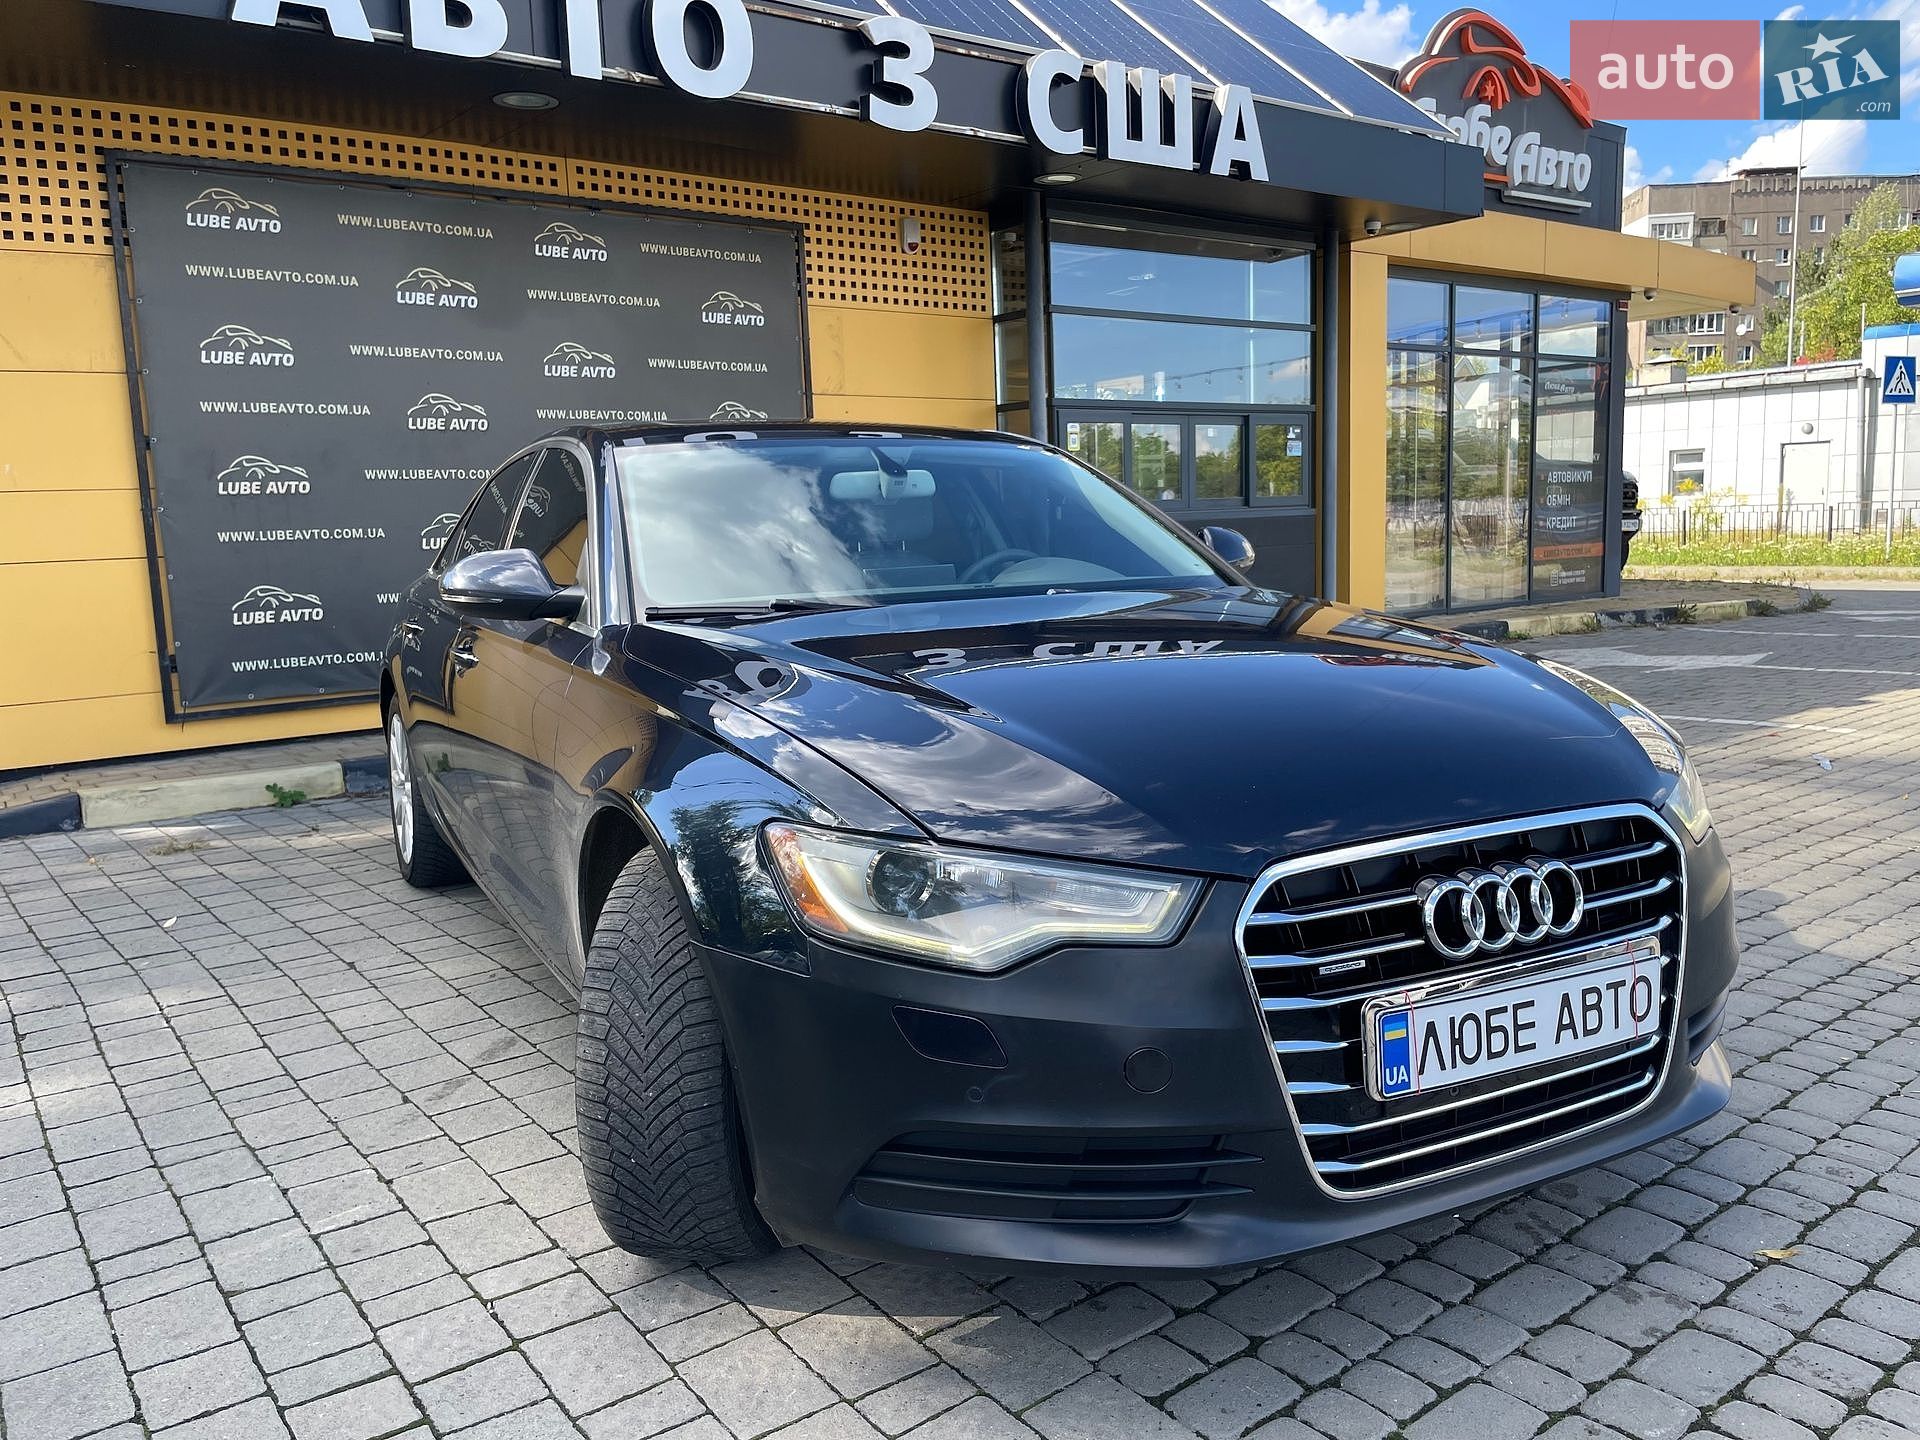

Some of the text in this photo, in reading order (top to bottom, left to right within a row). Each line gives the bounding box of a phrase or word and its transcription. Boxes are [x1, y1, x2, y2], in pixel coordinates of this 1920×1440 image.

[1024, 49, 1269, 182] США
[187, 213, 281, 233] LUBE AVTO
[337, 214, 493, 238] WWW.LUBEAVTO.COM.UA
[535, 245, 607, 262] LUBE AVTO
[641, 243, 761, 263] WWW.LUBEAVTO.COM.UA
[186, 265, 358, 286] WWW.LUBEAVTO.COM.UA
[397, 291, 477, 308] LUBE AVTO
[528, 290, 660, 307] WWW.LUBEAVTO.COM.UA
[703, 312, 765, 326] LUBE AVTO
[201, 351, 294, 366] LUBE AVTO
[350, 345, 503, 361] WWW.LUBEAVTO.COM.UA
[545, 365, 615, 378] LUBE AVTO
[648, 359, 767, 372] WWW.LUBEAVTO.COM.UA
[200, 402, 370, 415] WWW.LUBEAVTO.COM.UA
[409, 418, 488, 430] LUBE AVTO
[1547, 470, 1593, 483] АВТОВИКУП
[219, 481, 310, 494] LUBE AVTO
[1546, 494, 1571, 506] ОБМІН
[1546, 516, 1577, 530] КРЕДИТ
[217, 528, 385, 542] WWW.LUBEAVTO.COM.UA
[233, 608, 323, 625] LUBE AVTO
[232, 651, 383, 672] WWW.LUBEAVTO.COM.
[1417, 975, 1653, 1076] ЛЮБЕ АВТО
[1385, 1065, 1410, 1086] UA
